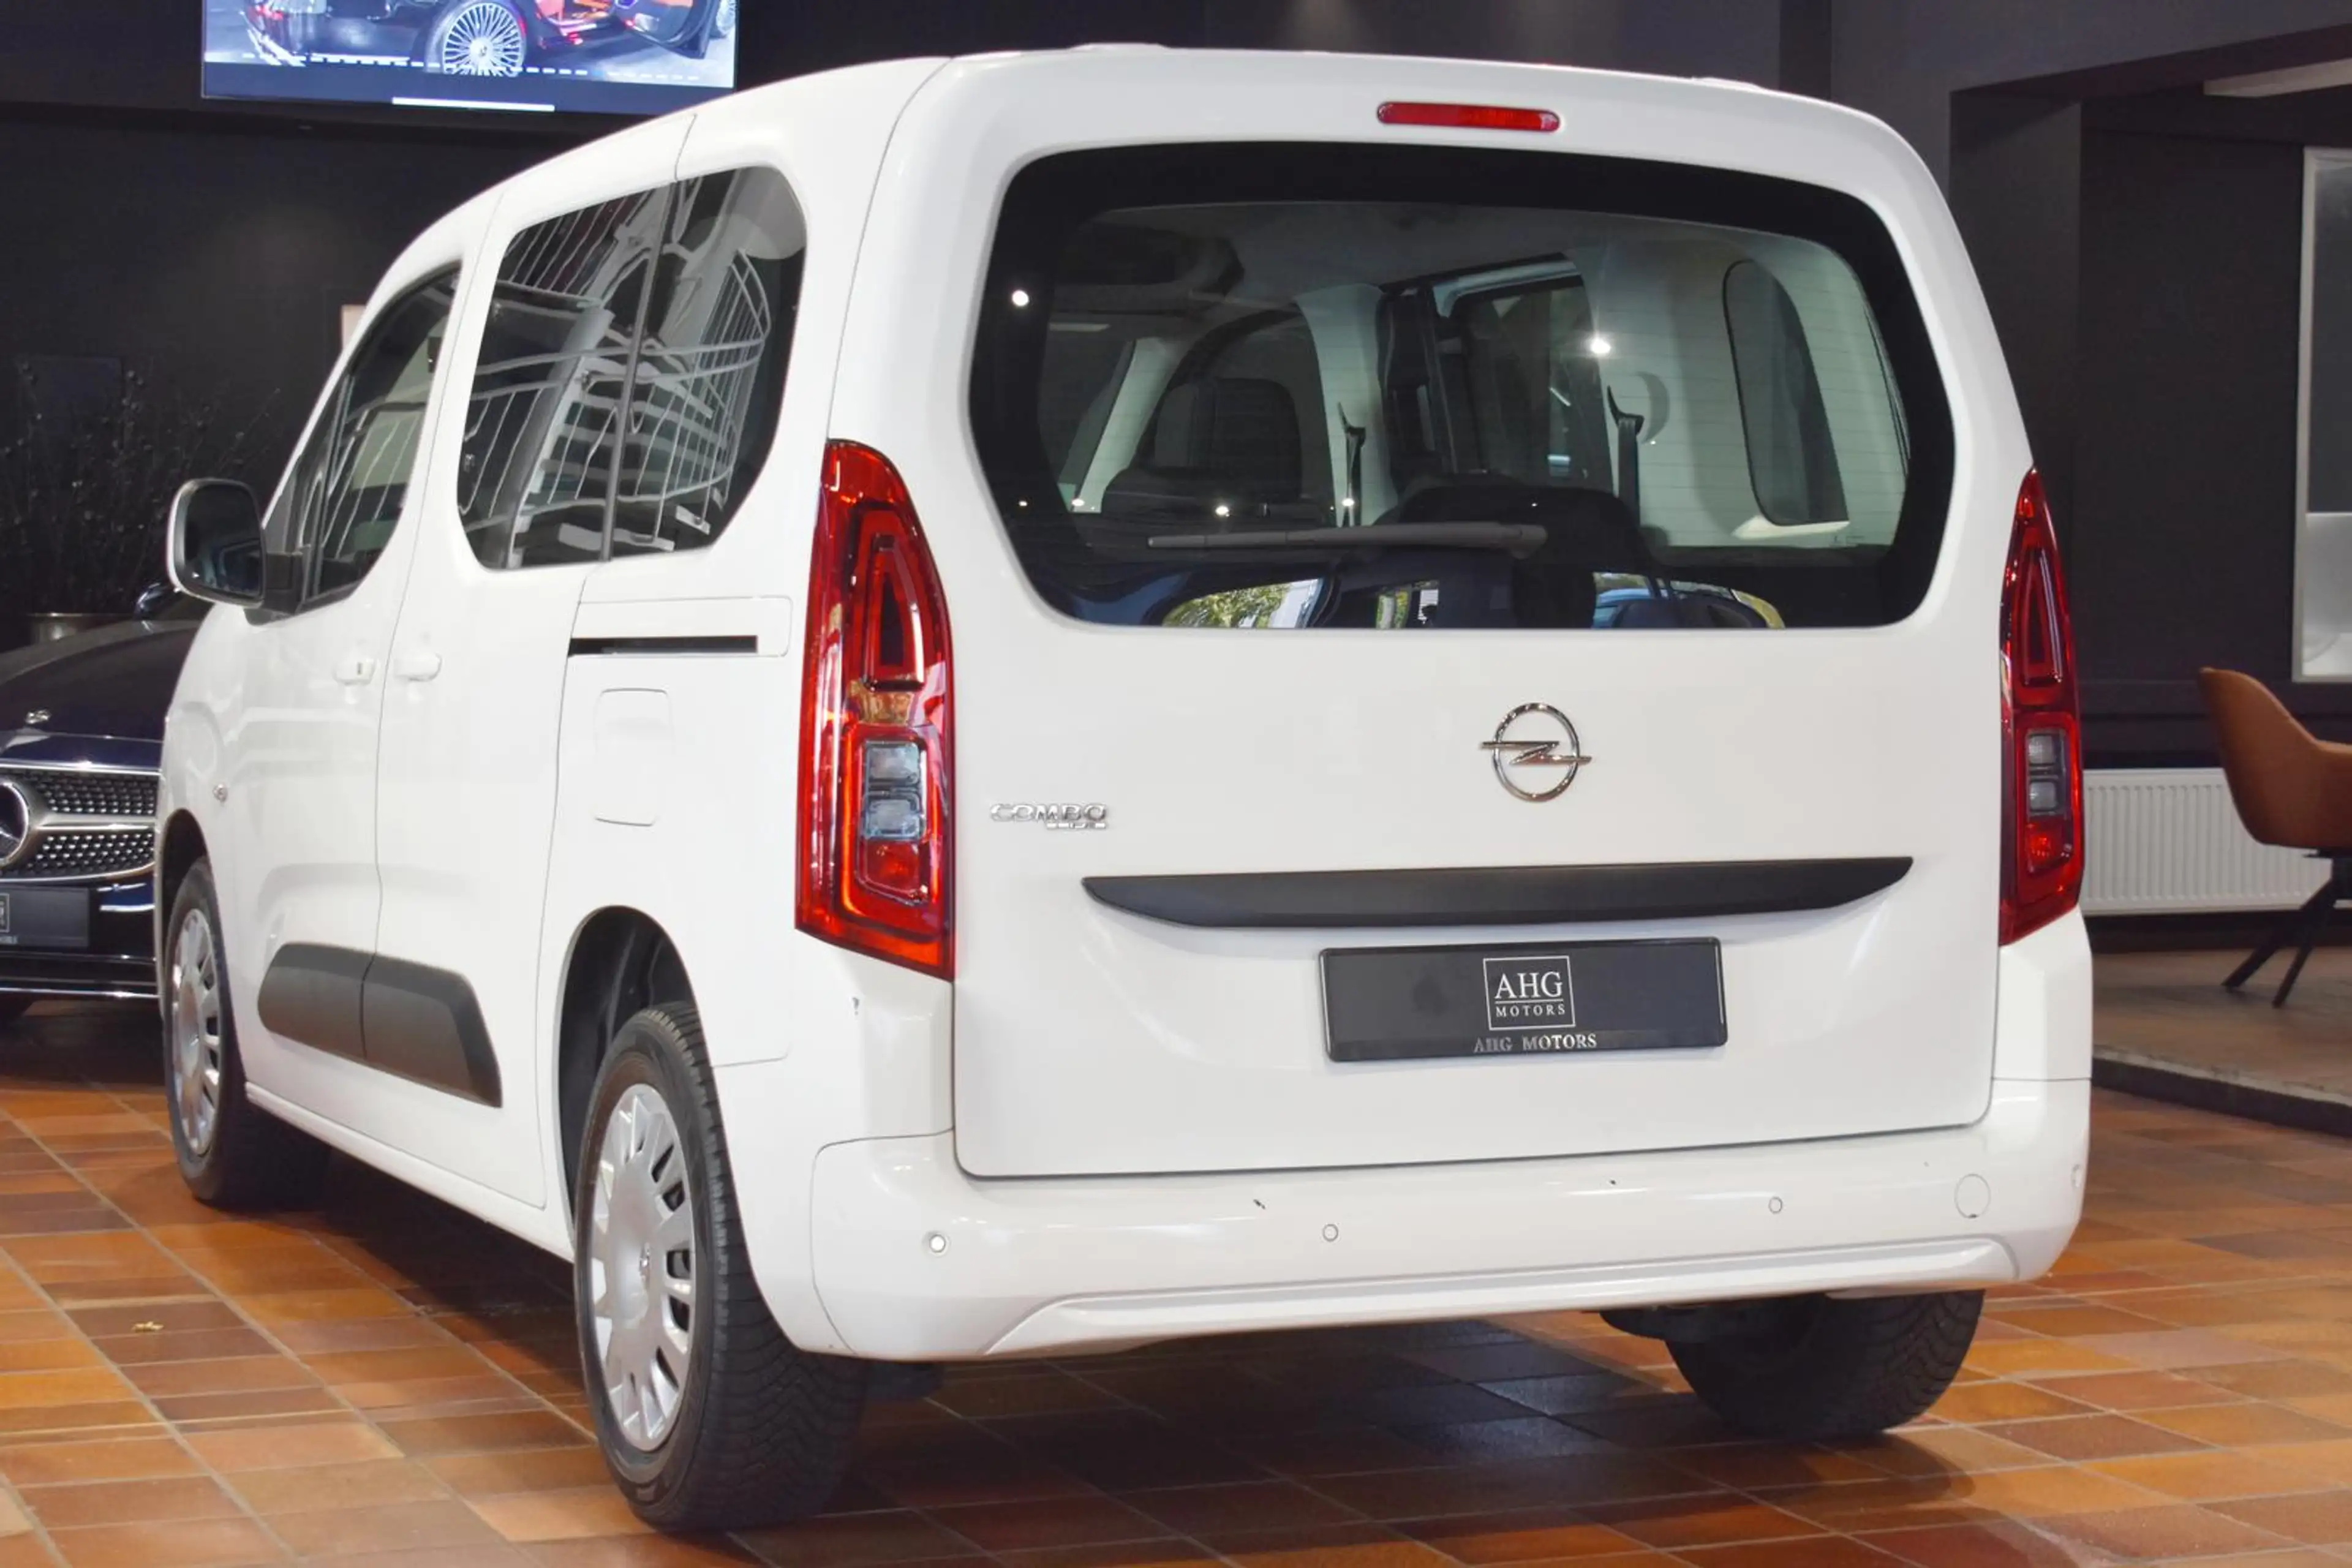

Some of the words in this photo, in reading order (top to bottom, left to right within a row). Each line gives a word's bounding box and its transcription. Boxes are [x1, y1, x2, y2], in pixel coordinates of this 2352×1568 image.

[990, 804, 1106, 821] COMBO
[1494, 971, 1563, 999] AHG
[1495, 1003, 1566, 1017] MOTORS
[1473, 1036, 1513, 1054] AHG
[1522, 1033, 1598, 1052] MOTORS
